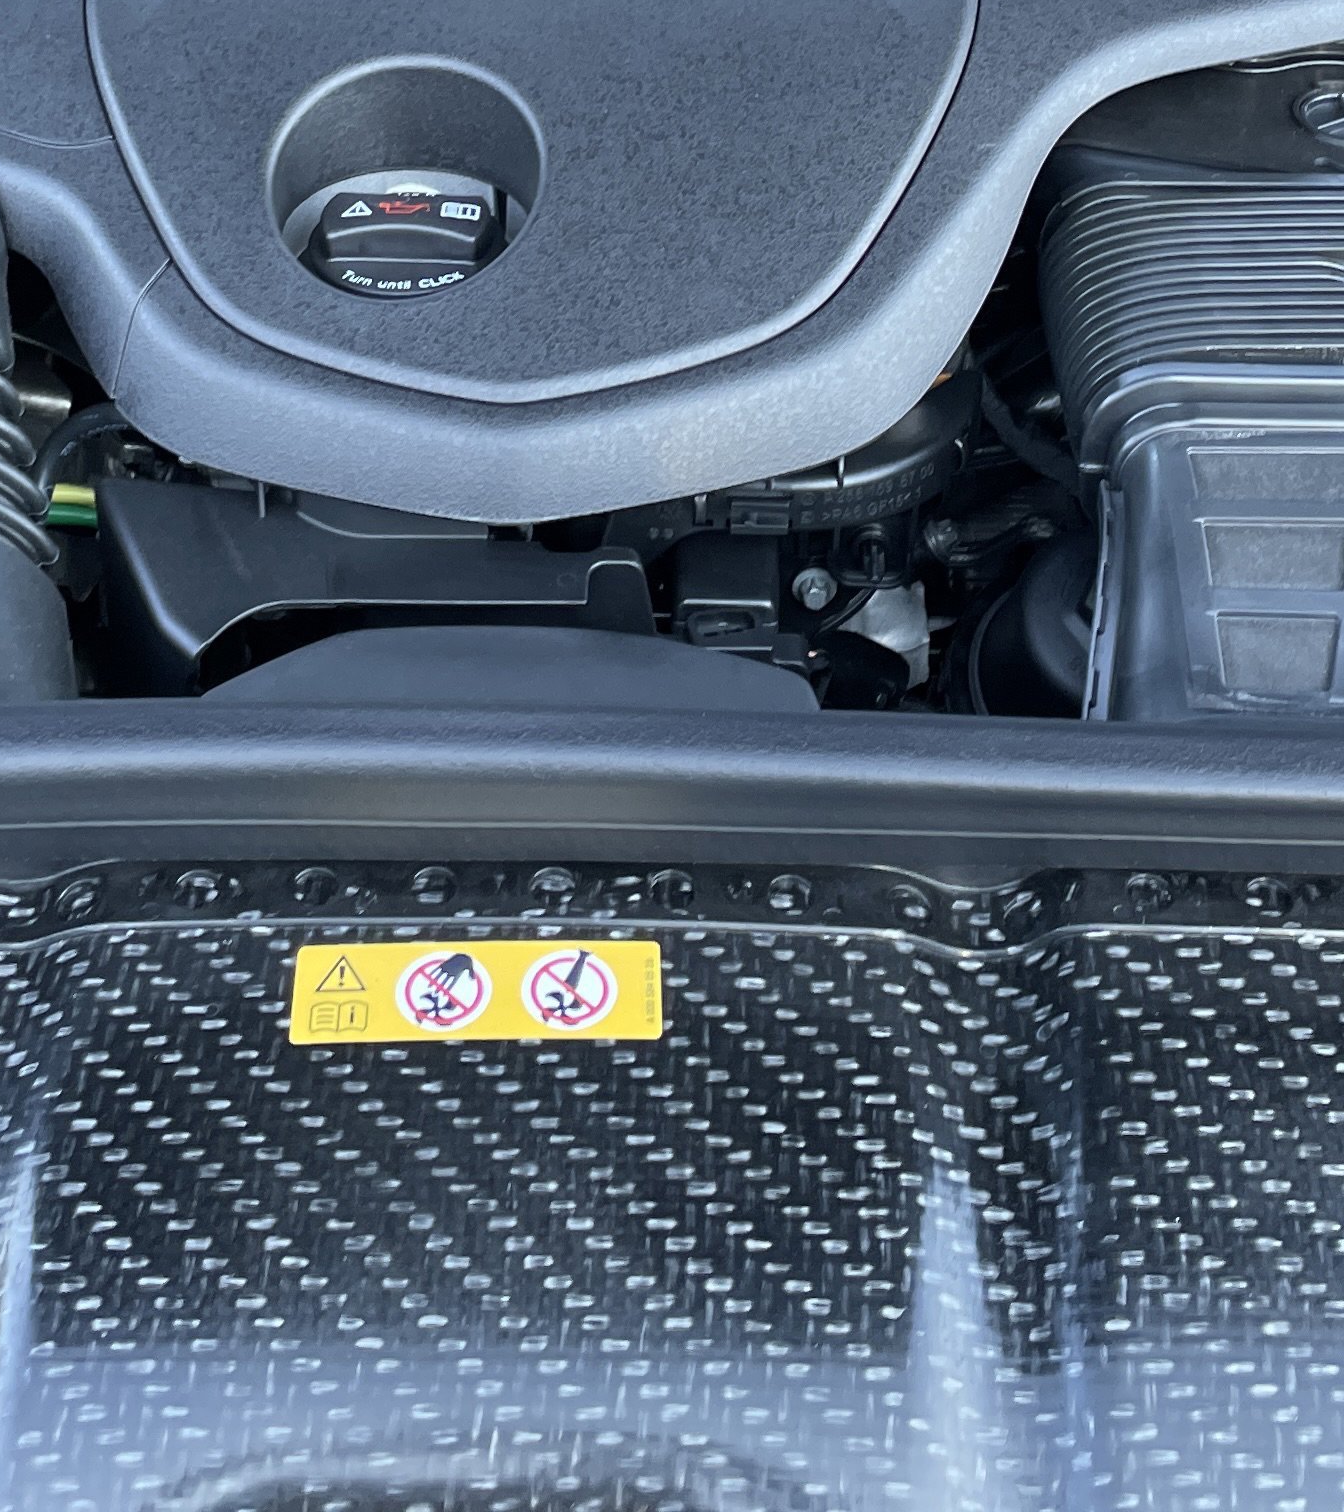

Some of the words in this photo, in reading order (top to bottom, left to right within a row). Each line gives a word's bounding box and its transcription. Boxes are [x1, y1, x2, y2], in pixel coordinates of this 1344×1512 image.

[340, 269, 374, 287] Turn
[376, 279, 412, 290] until
[418, 270, 465, 289] CLICK
